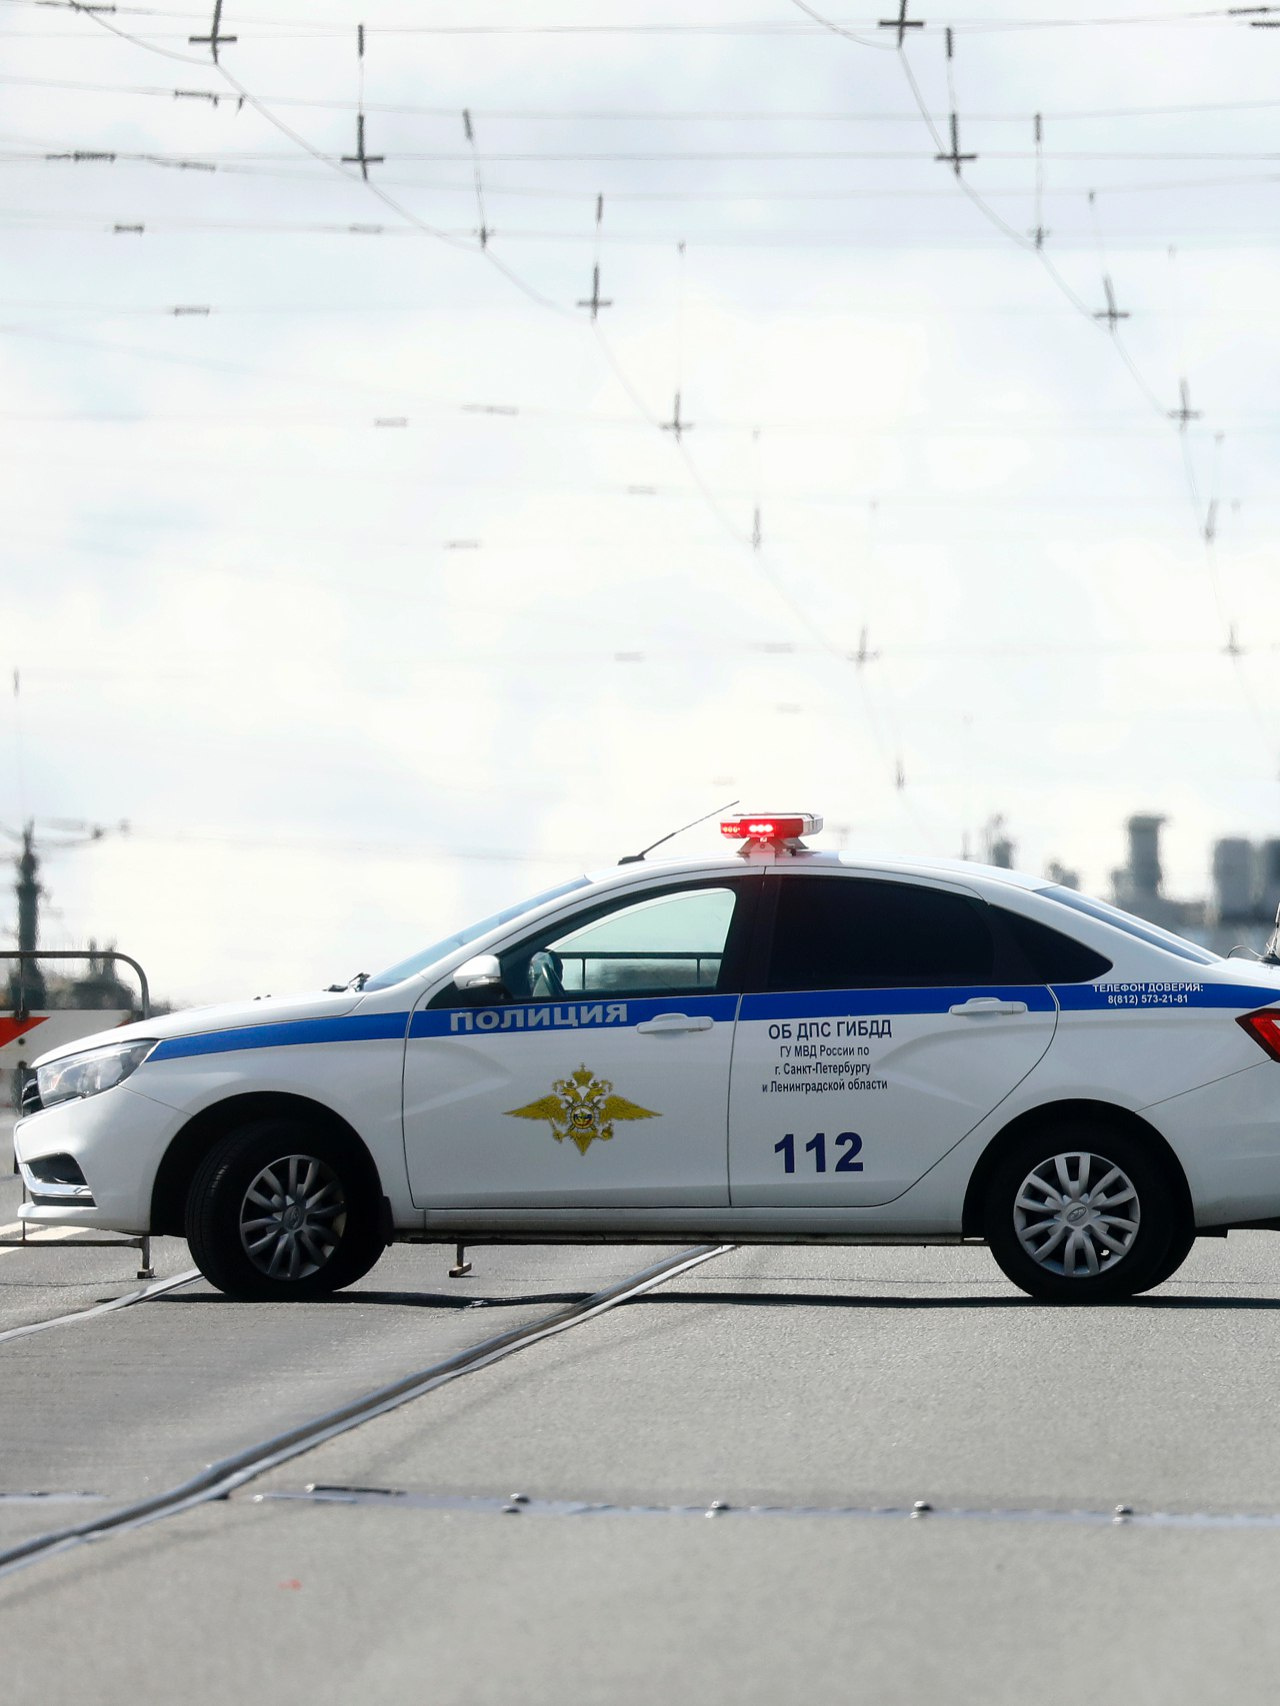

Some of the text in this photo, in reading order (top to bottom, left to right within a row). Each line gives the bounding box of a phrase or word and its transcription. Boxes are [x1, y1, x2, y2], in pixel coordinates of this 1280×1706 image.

[1093, 983, 1204, 992] ТЕЛЕФОН ДОВЕРИЯ:
[1108, 994, 1188, 1005] 8(812) 573-21-81
[450, 1004, 627, 1031] ПОЛИЦИЯ
[769, 1020, 892, 1041] ОБ ДПС ГИБДД
[780, 1045, 869, 1058] ГУ МВД России по
[775, 1062, 870, 1075] г. Санкт-Петербургу
[762, 1078, 888, 1094] и Ленинградской области
[774, 1132, 863, 1173] 112
